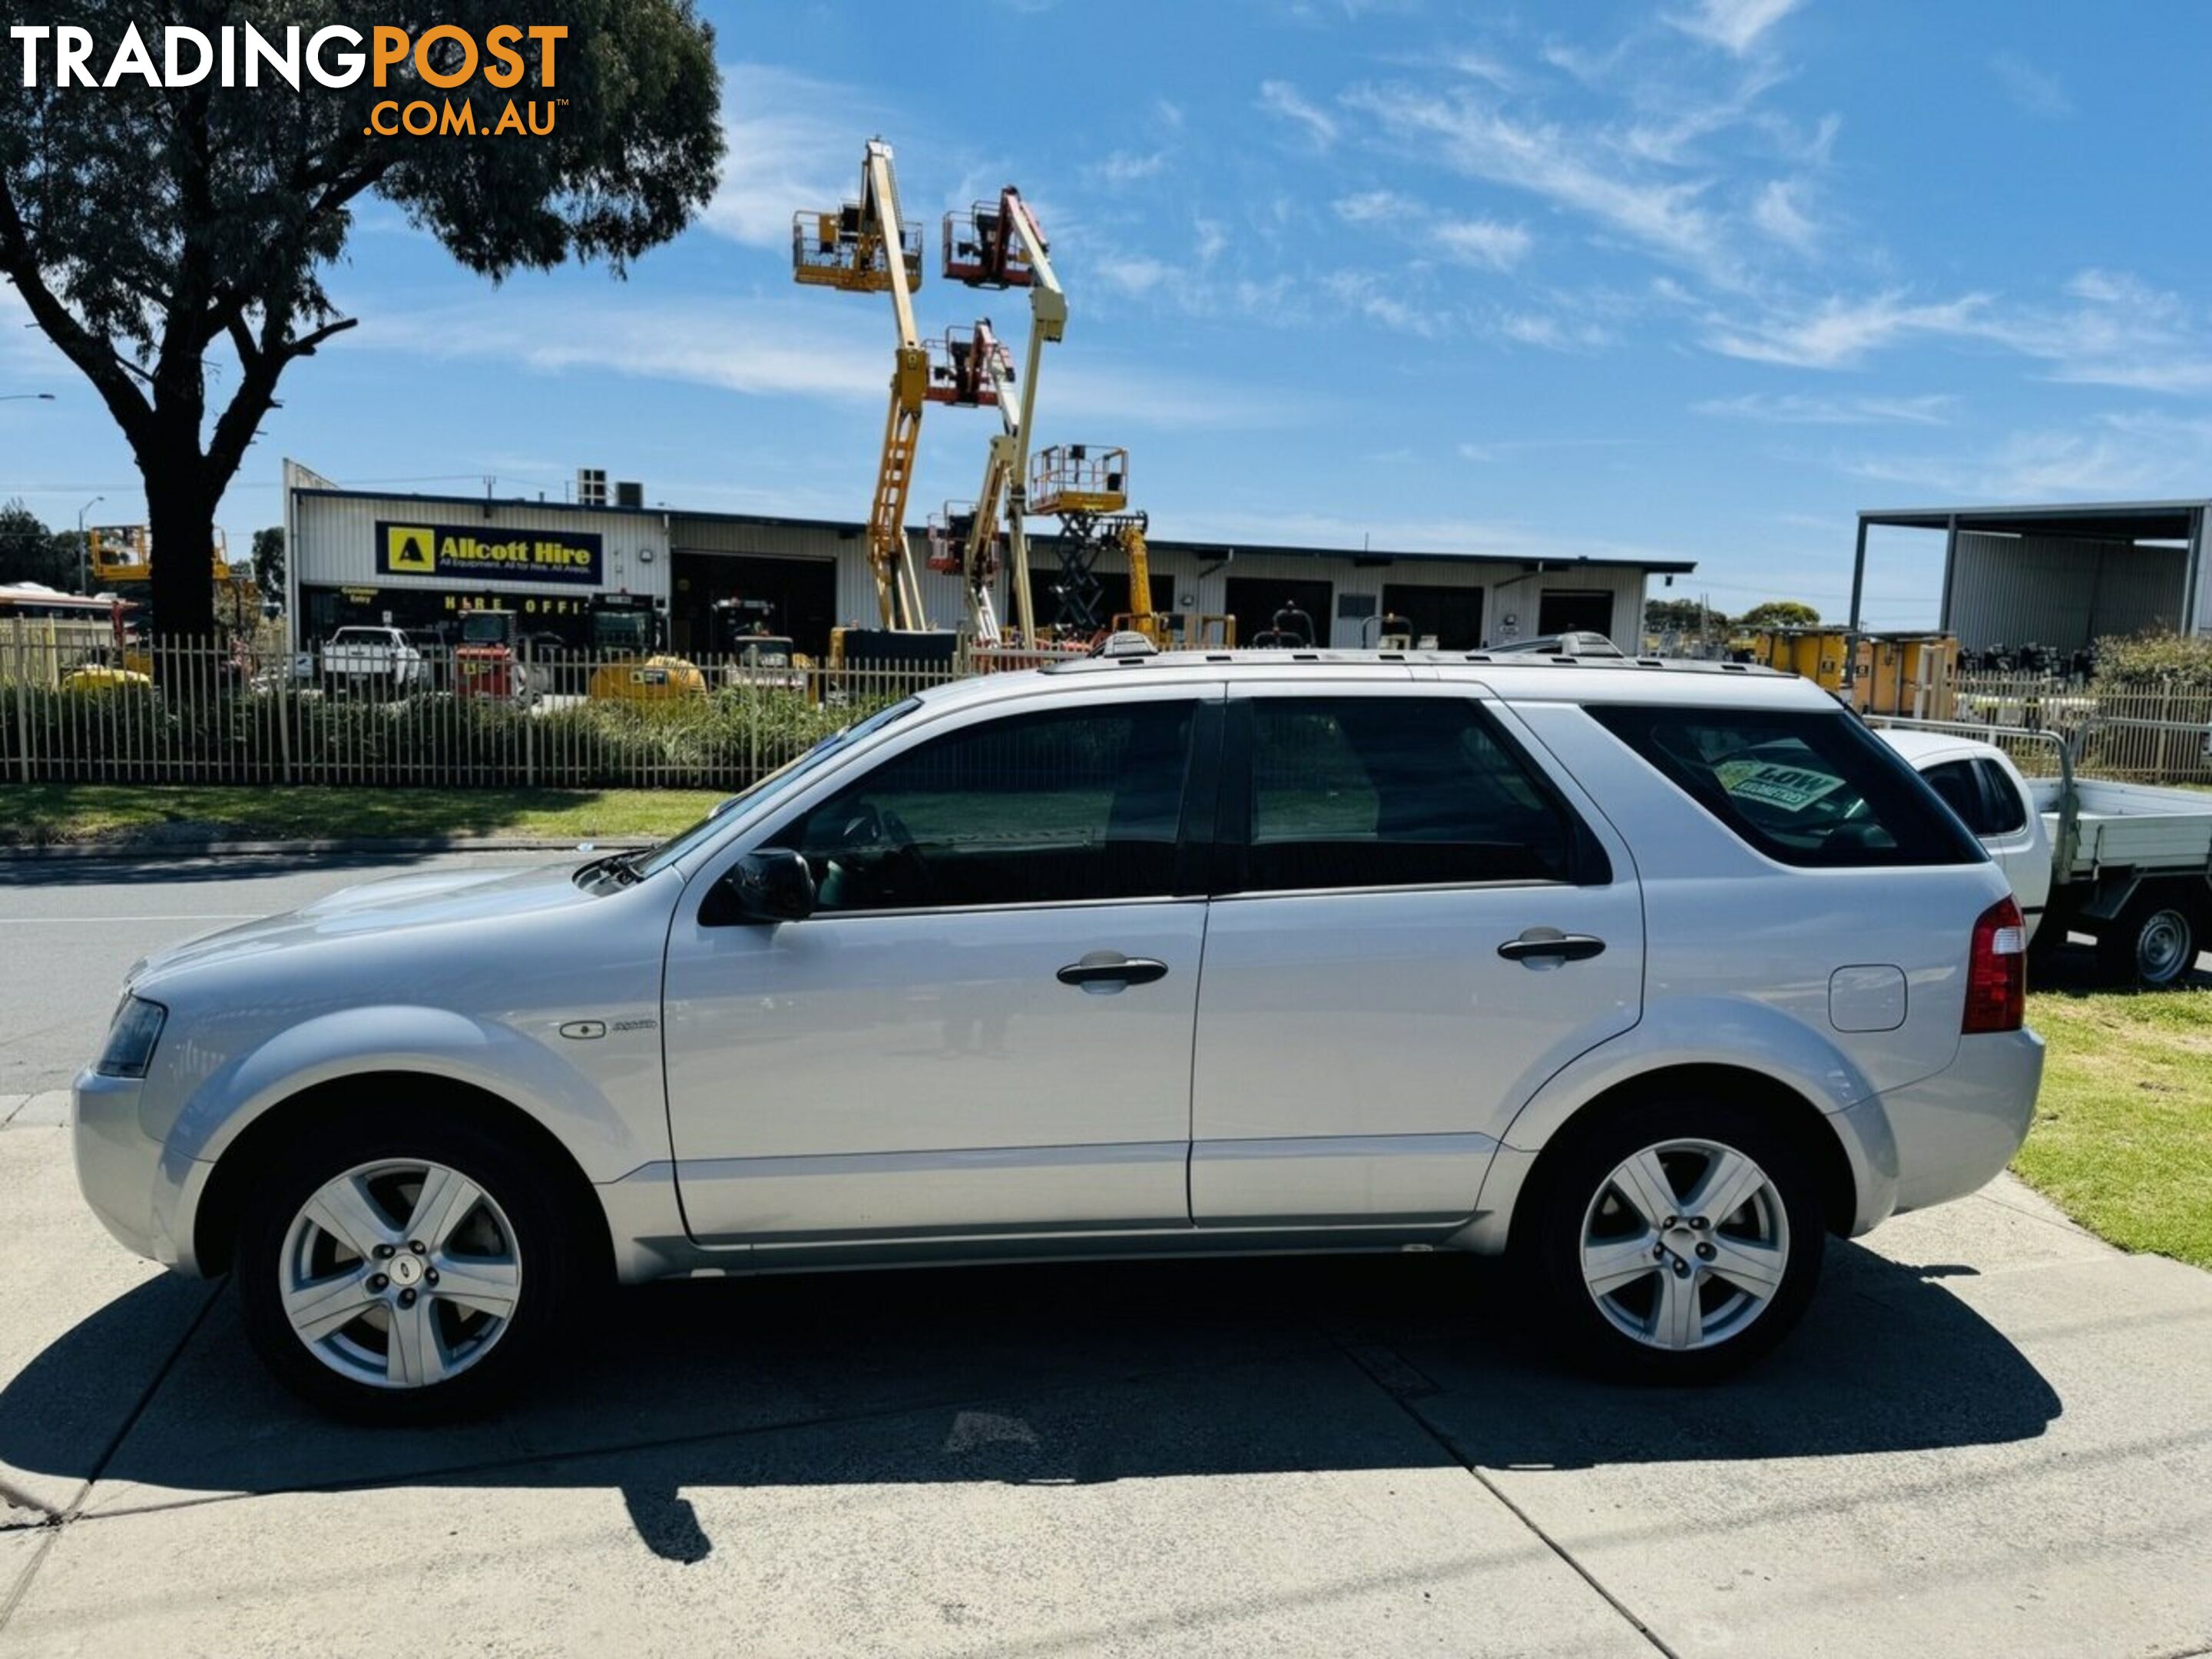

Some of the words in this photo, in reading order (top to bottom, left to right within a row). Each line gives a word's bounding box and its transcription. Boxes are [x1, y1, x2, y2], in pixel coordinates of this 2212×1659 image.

[440, 537, 528, 562] Allcott
[535, 542, 591, 565] Hire
[1755, 767, 1836, 792] LOW
